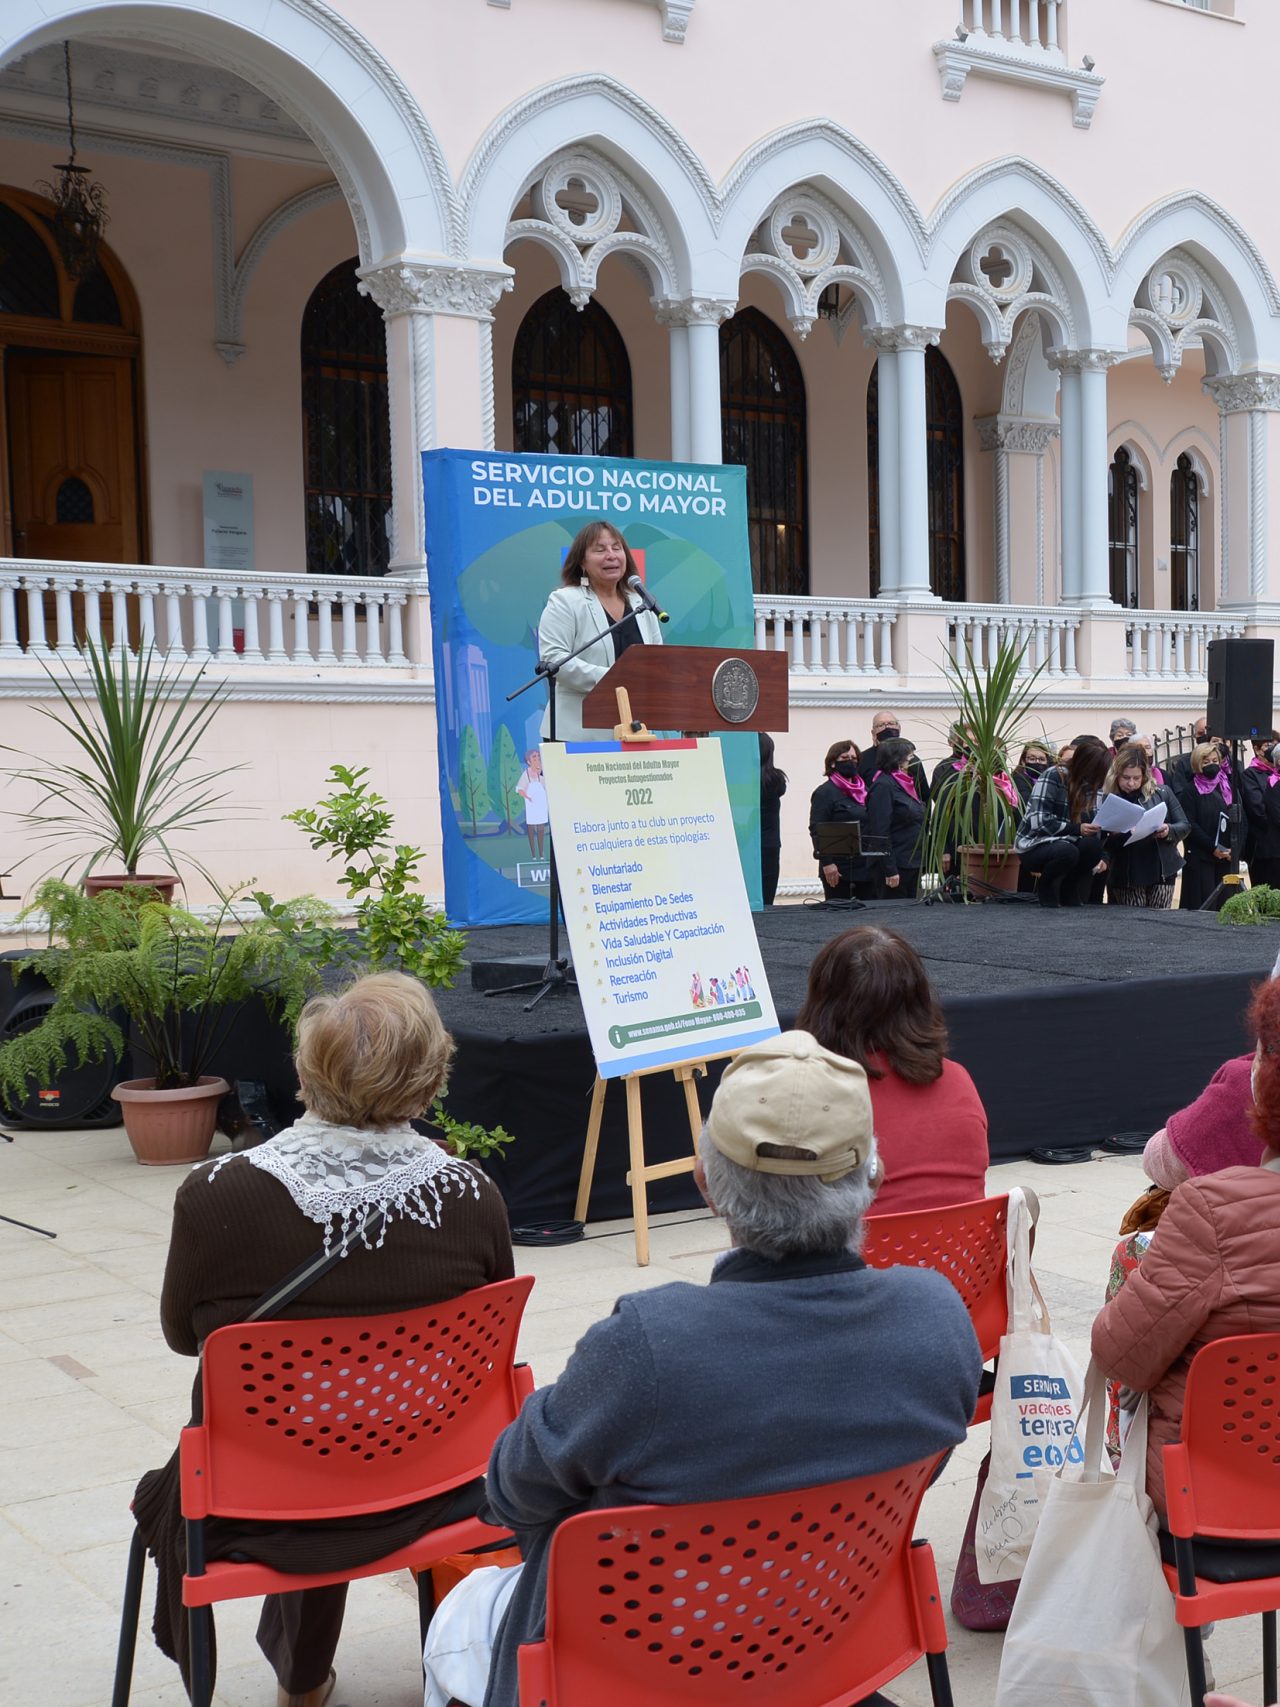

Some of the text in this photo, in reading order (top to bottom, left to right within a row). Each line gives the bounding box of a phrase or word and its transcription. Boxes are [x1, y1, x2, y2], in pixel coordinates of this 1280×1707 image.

[471, 461, 722, 492] SERVICIO NACIONAL
[474, 487, 726, 516] DEL ADULTO MAYOR
[586, 760, 679, 772] Fondo Nacional del Adulto Mayor
[599, 773, 673, 785] Proyectos Autogestionados
[625, 788, 653, 805] 2022
[574, 813, 715, 834] Elabora junto a tu club un proyecto
[576, 830, 710, 852] en cualquiera de estas tipologías:
[588, 861, 643, 877] Voluntariado
[592, 881, 632, 896] Bienestar
[595, 892, 694, 914] Equipamiento De Sedes
[599, 910, 698, 932] Actividades Productivas
[601, 923, 725, 950] Vida Saludable Y Capacitación
[606, 948, 673, 968] Inclusión Digital
[610, 969, 657, 987] Recreación
[613, 990, 648, 1005] Turismo
